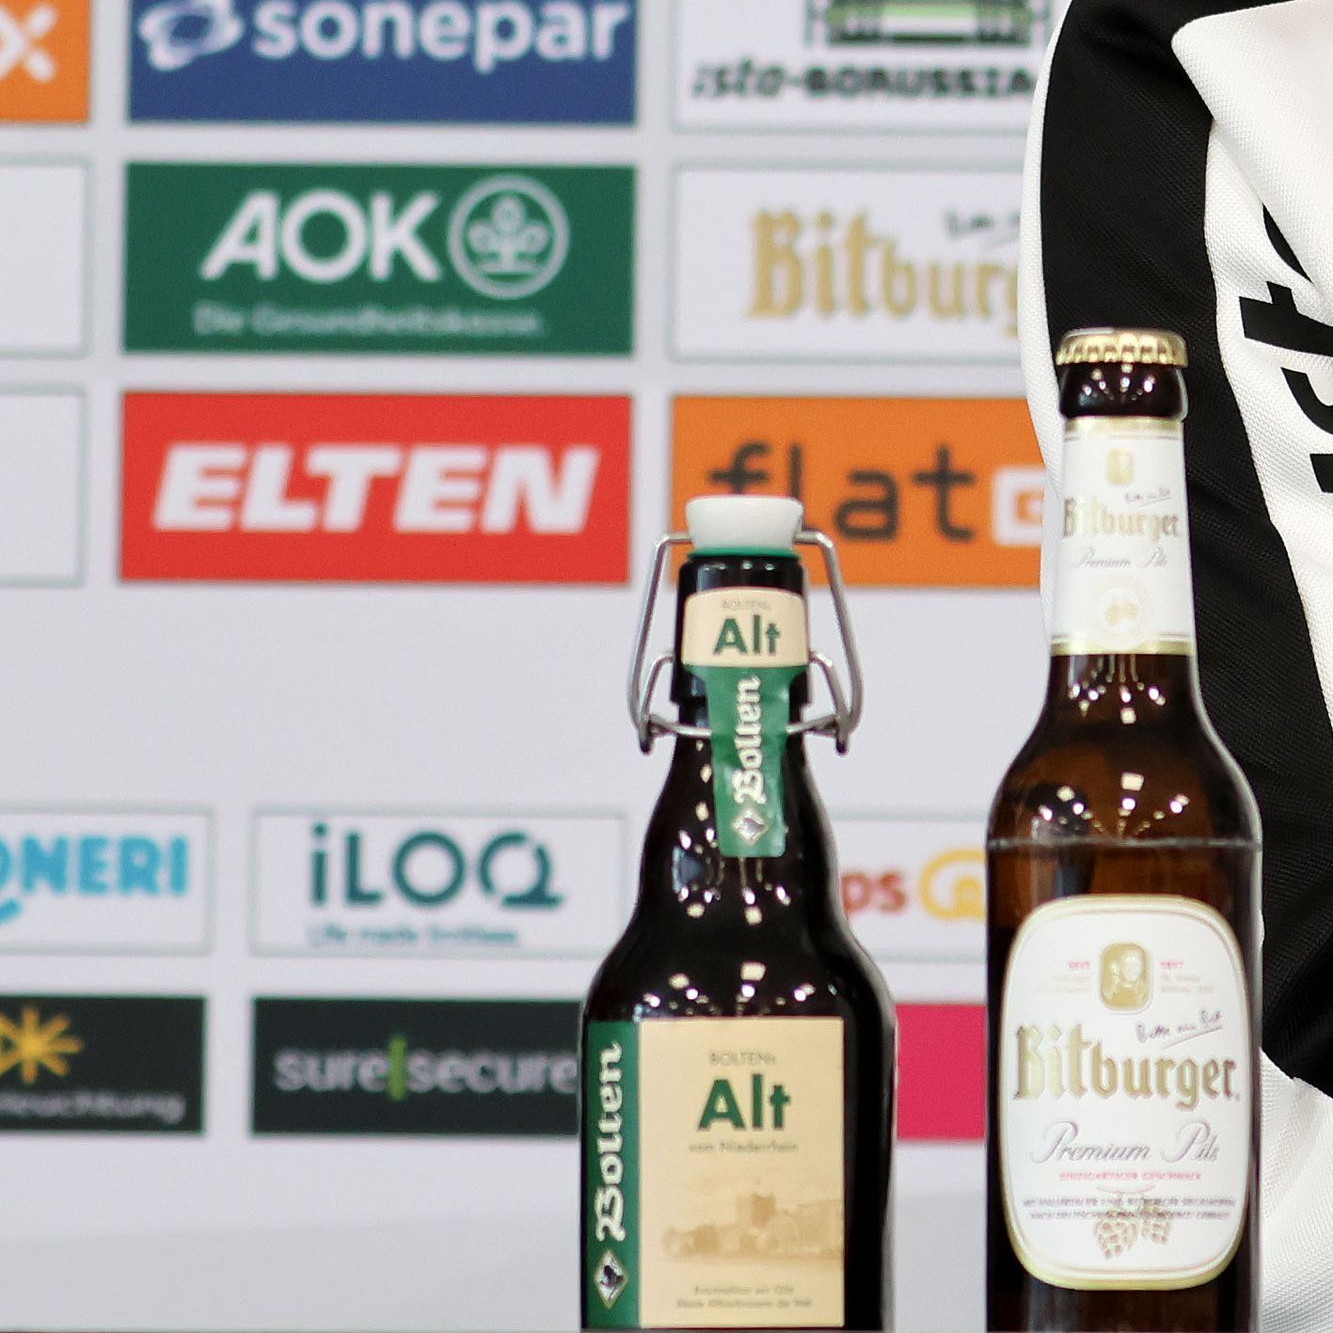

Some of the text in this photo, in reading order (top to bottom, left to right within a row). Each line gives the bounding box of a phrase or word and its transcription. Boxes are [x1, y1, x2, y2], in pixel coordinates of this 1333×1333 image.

[200, 186, 444, 284] AOK
[152, 441, 600, 537] ELTEN
[1062, 495, 1182, 544] Bitburger
[712, 613, 783, 657] Alt
[730, 675, 768, 804] Bolten
[311, 821, 566, 910] iLOQ
[697, 1070, 792, 1132] Alt
[1013, 1023, 1238, 1112] Bitburger
[593, 1039, 628, 1244] Bolten
[1029, 1120, 1221, 1165] Premium Pils
